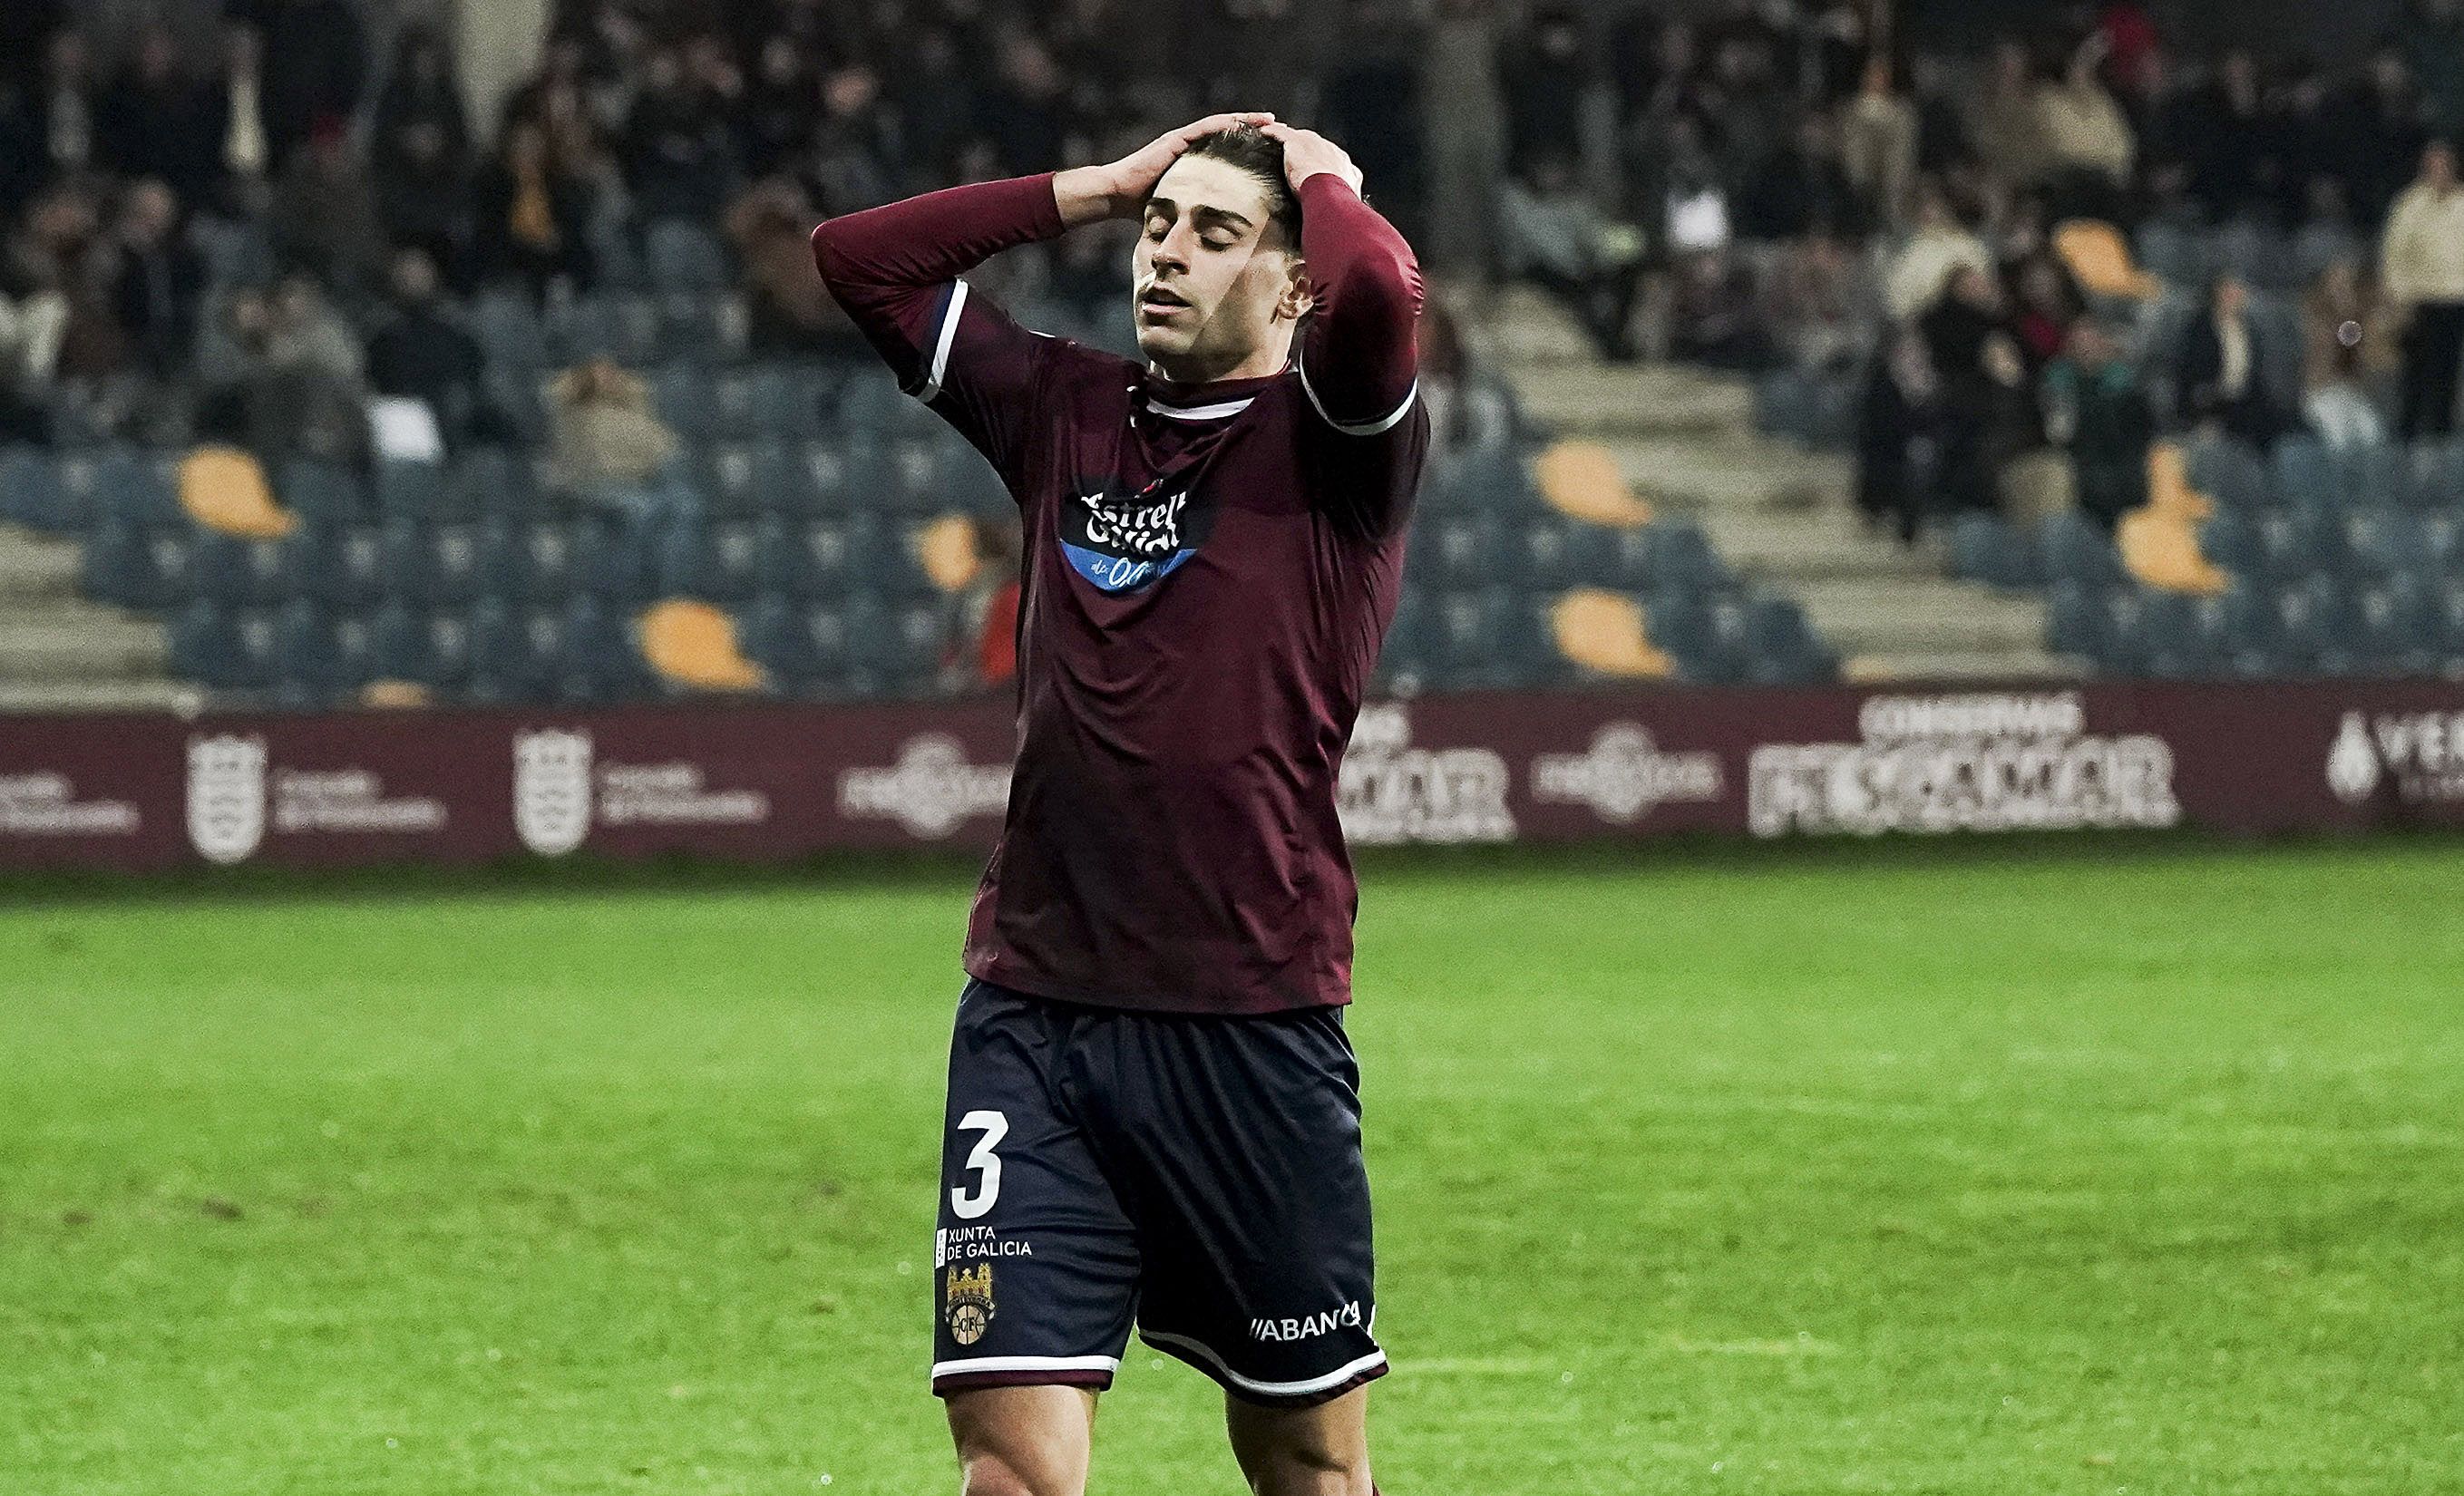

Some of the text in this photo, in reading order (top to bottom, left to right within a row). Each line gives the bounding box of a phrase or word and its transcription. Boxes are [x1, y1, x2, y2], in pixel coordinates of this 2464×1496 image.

[1081, 491, 1186, 529] Estrel
[951, 1110, 1009, 1219] 3
[949, 1227, 996, 1243] XUNTA
[948, 1245, 962, 1261] DE
[966, 1241, 1032, 1258] GALICIA
